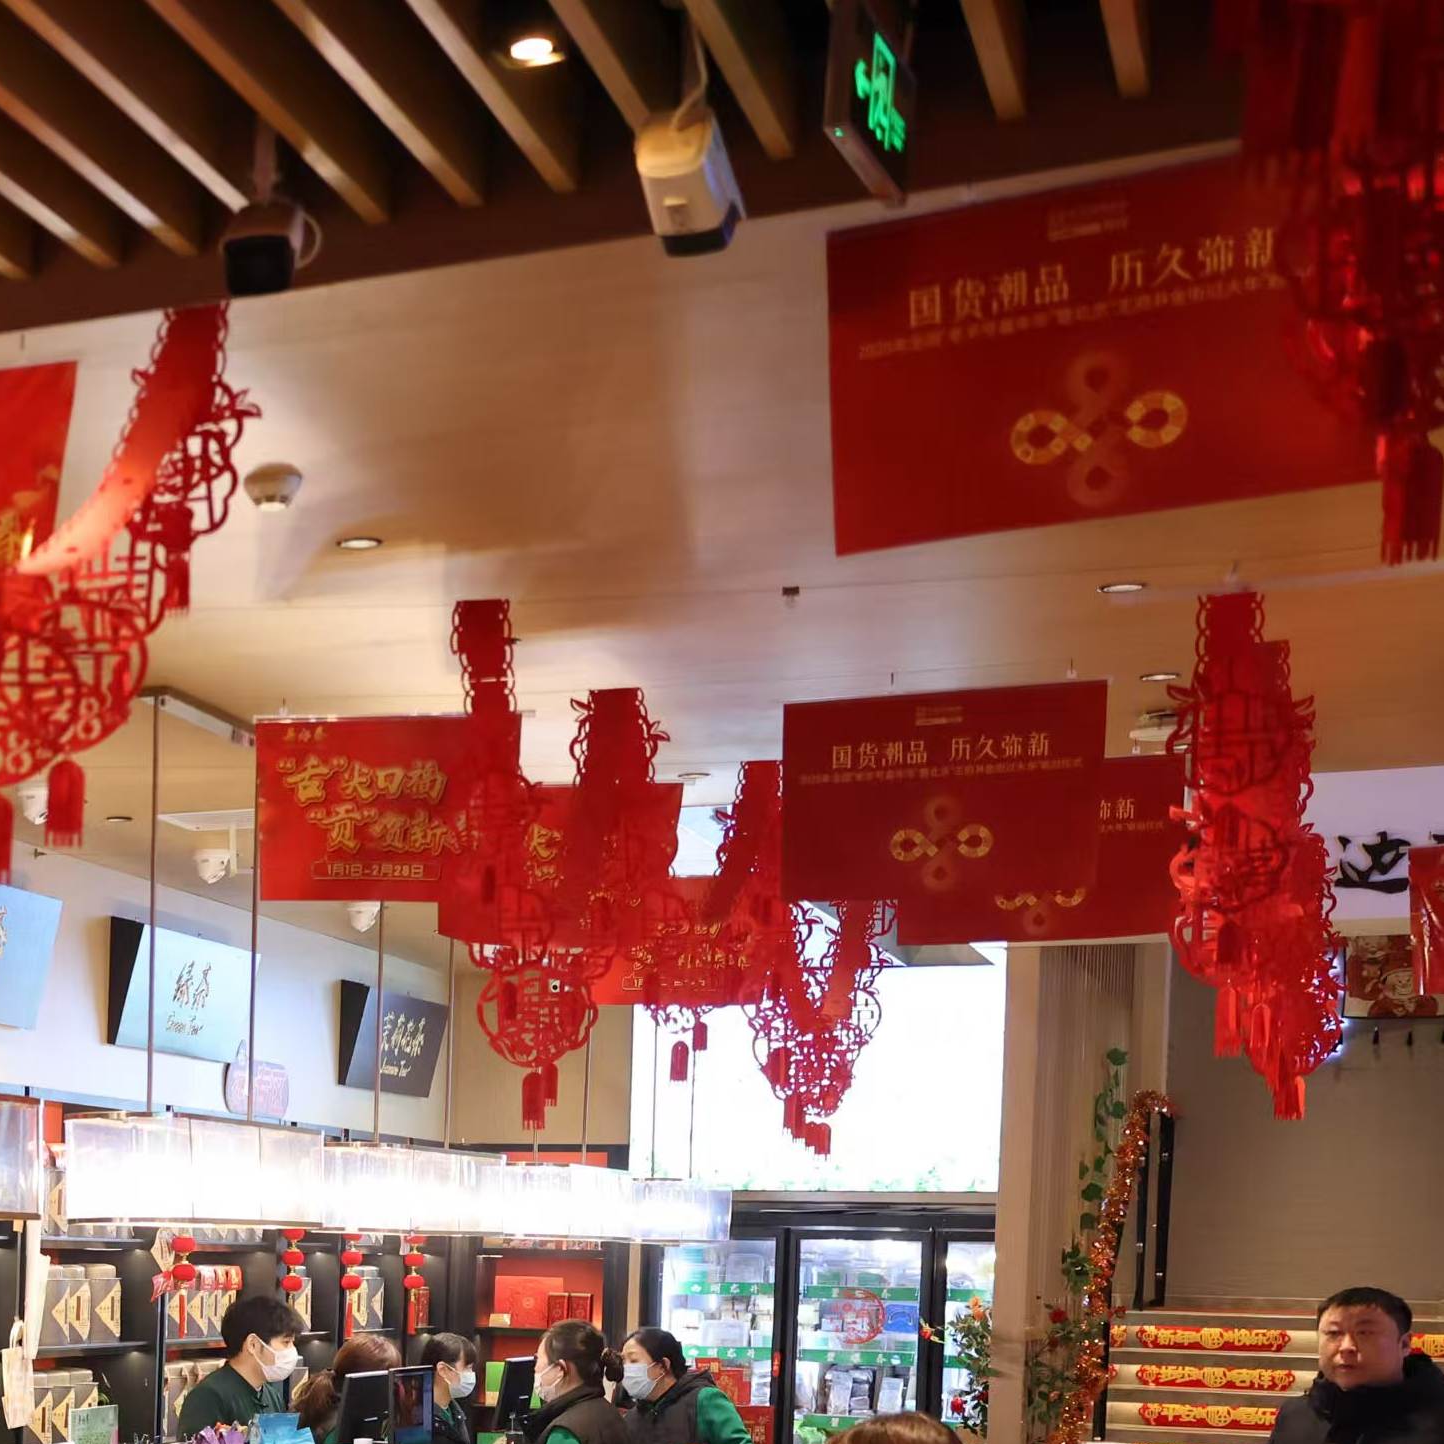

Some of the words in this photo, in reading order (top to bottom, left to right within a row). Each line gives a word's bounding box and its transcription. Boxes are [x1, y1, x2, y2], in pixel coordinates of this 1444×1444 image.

[909, 262, 1070, 329] 国货潮品
[1111, 226, 1276, 293] 历久弥新
[832, 741, 927, 769] 国货潮品
[949, 732, 1050, 762] 历久弥新
[327, 864, 424, 878] 1月1日-2月28日
